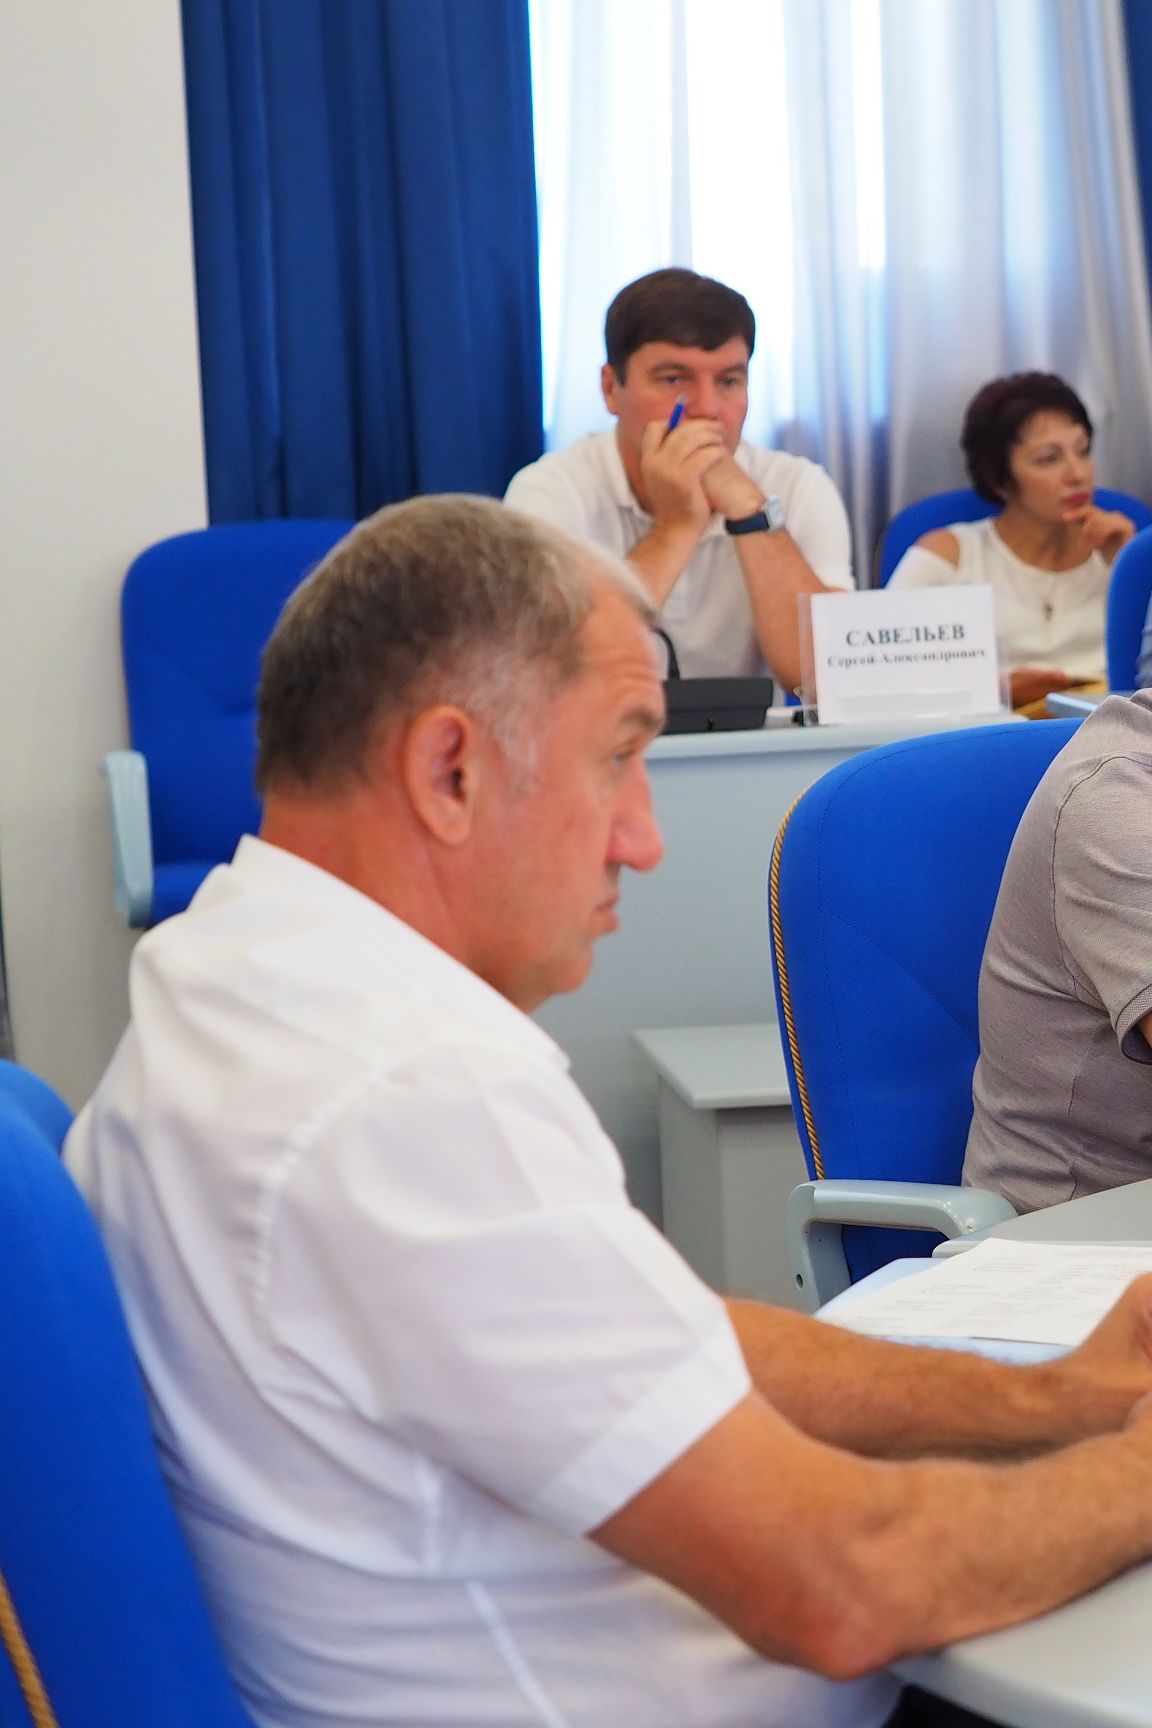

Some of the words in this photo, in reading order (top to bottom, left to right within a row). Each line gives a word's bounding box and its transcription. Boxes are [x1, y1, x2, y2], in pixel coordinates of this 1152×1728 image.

[845, 623, 966, 648] САВЕЛЬЕВ
[827, 654, 875, 669] Сергей
[881, 648, 986, 664] Александрович
